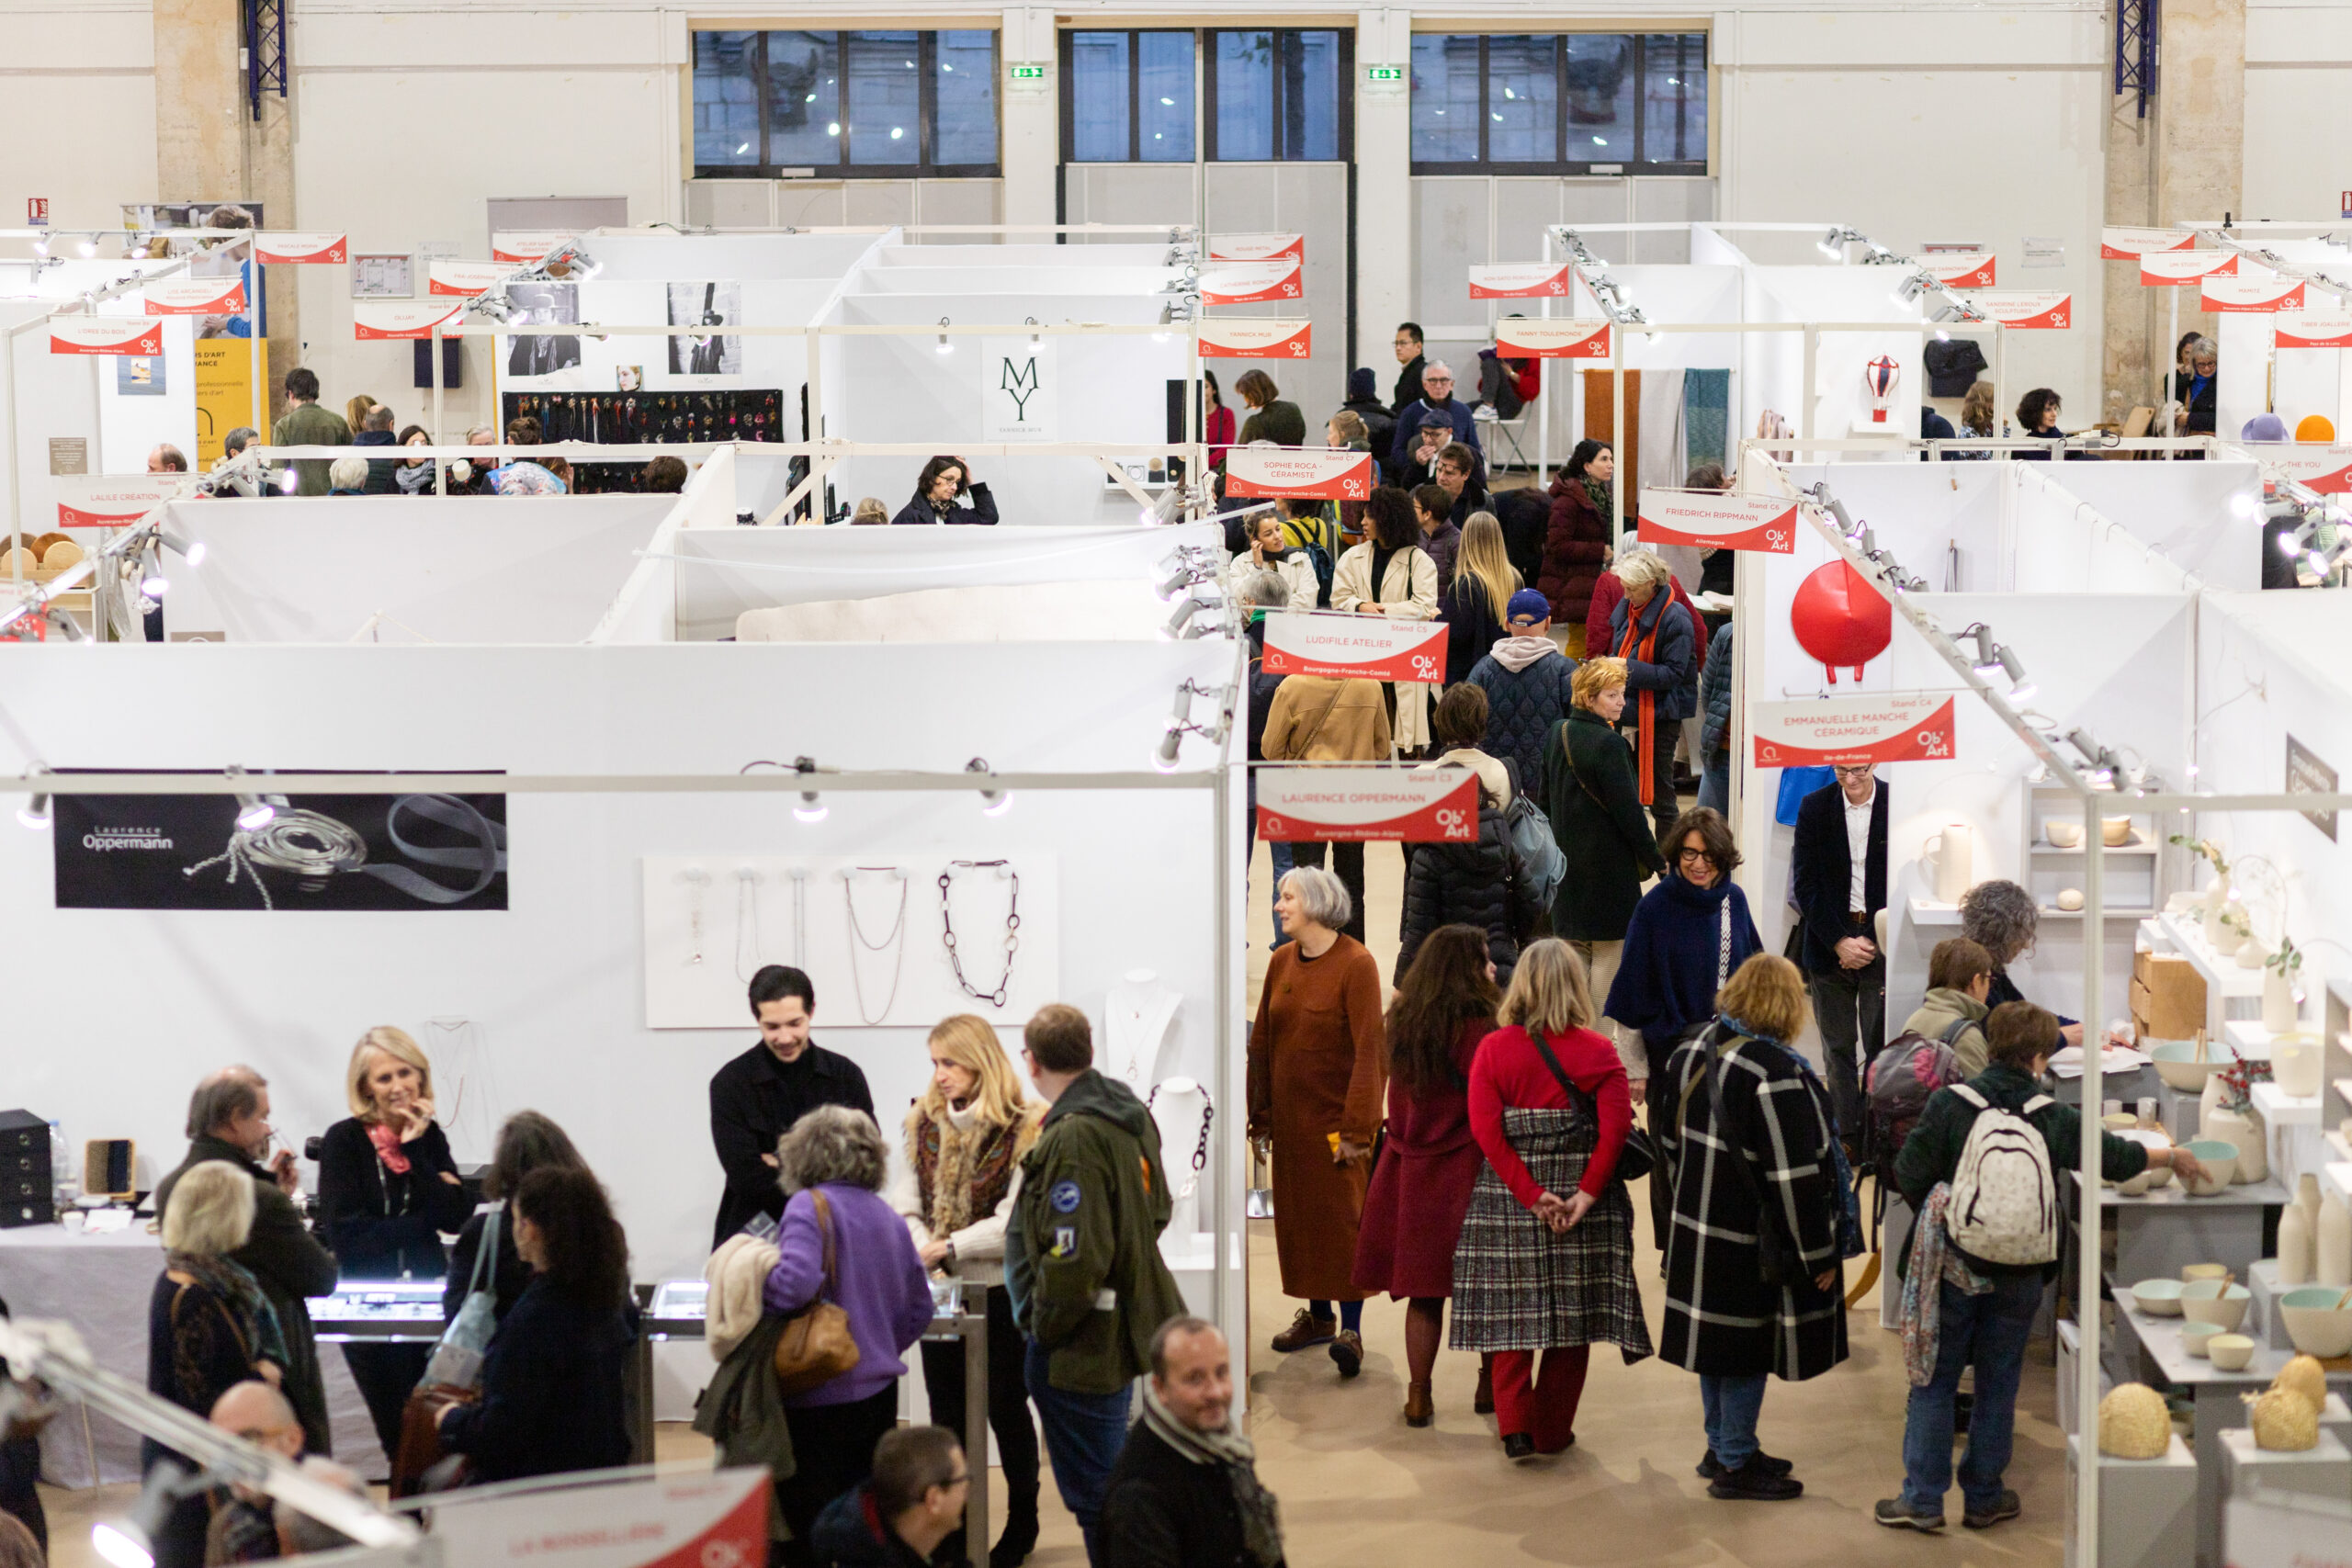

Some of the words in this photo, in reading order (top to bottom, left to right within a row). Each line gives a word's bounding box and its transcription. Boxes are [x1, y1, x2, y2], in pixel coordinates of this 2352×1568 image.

[1343, 479, 1362, 489] Ob'
[90, 493, 118, 502] LALILE
[1348, 488, 1364, 498] Art
[1666, 508, 1712, 518] FRIEDRICH
[1713, 511, 1758, 522] RIPPMANN
[1766, 529, 1787, 541] Ob'
[1771, 540, 1789, 551] Art
[1391, 625, 1413, 633] Stand
[1306, 636, 1349, 646] LUDIFILE
[1352, 637, 1393, 648] ATELIER
[1412, 655, 1436, 669] Ob'
[1303, 665, 1390, 677] Bourgogne-Franche-Comté
[1418, 668, 1439, 680] Art
[1892, 700, 1917, 708] Stand
[1784, 713, 1859, 726] EMMANUELLE
[1862, 712, 1909, 723] MANCHE
[1917, 730, 1944, 746] Ob'
[1926, 745, 1948, 757] Art
[1282, 793, 1345, 804] LAURENCE
[1350, 793, 1426, 804] OPPERMANN
[1436, 808, 1466, 826] Ob'
[95, 825, 162, 833] Laurence
[1314, 829, 1404, 839] Auvergne-Rhône-Alpes
[1445, 824, 1470, 838] Art
[83, 834, 174, 852] Oppermann
